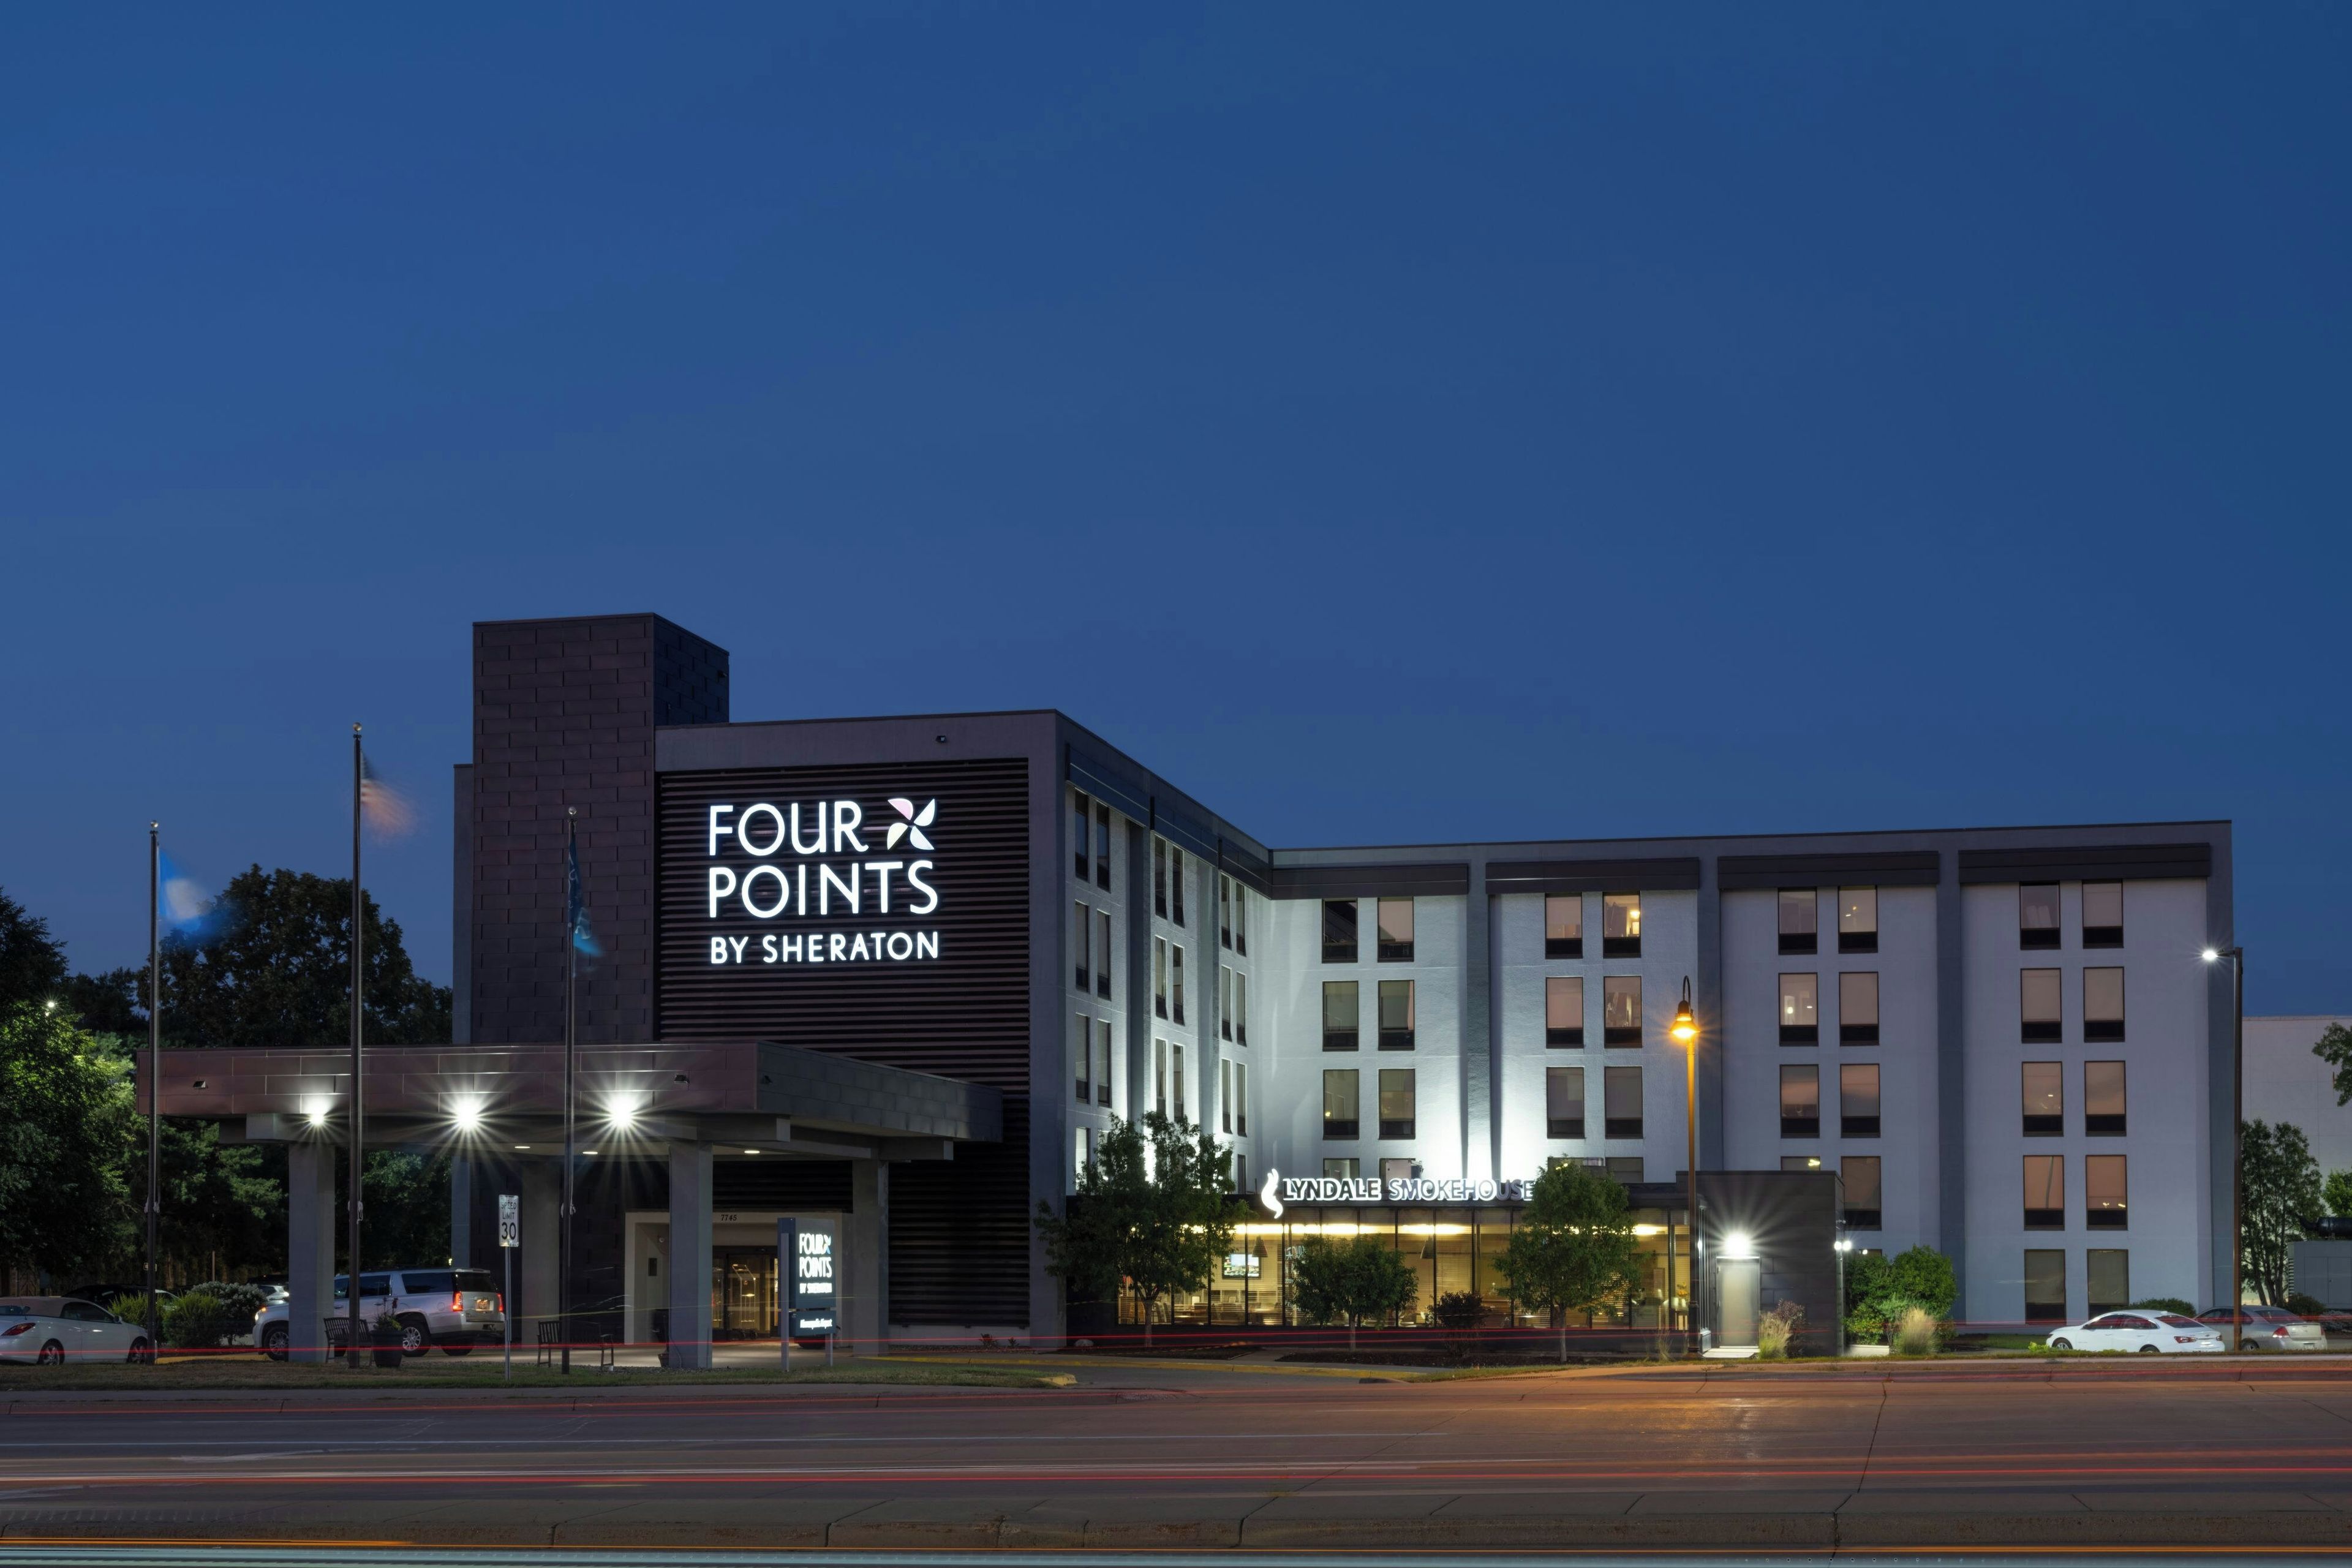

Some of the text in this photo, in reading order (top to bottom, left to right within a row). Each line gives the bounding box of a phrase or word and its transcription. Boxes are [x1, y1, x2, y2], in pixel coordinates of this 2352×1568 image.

[709, 801, 869, 856] FOUR
[709, 860, 938, 918] POINTS
[710, 931, 938, 963] BY SHERATON
[1283, 1177, 1536, 1201] LYNDALE SMOKEHOUSE
[502, 1222, 516, 1240] 30
[799, 1233, 824, 1255] FOUR
[799, 1256, 832, 1278] POINTS
